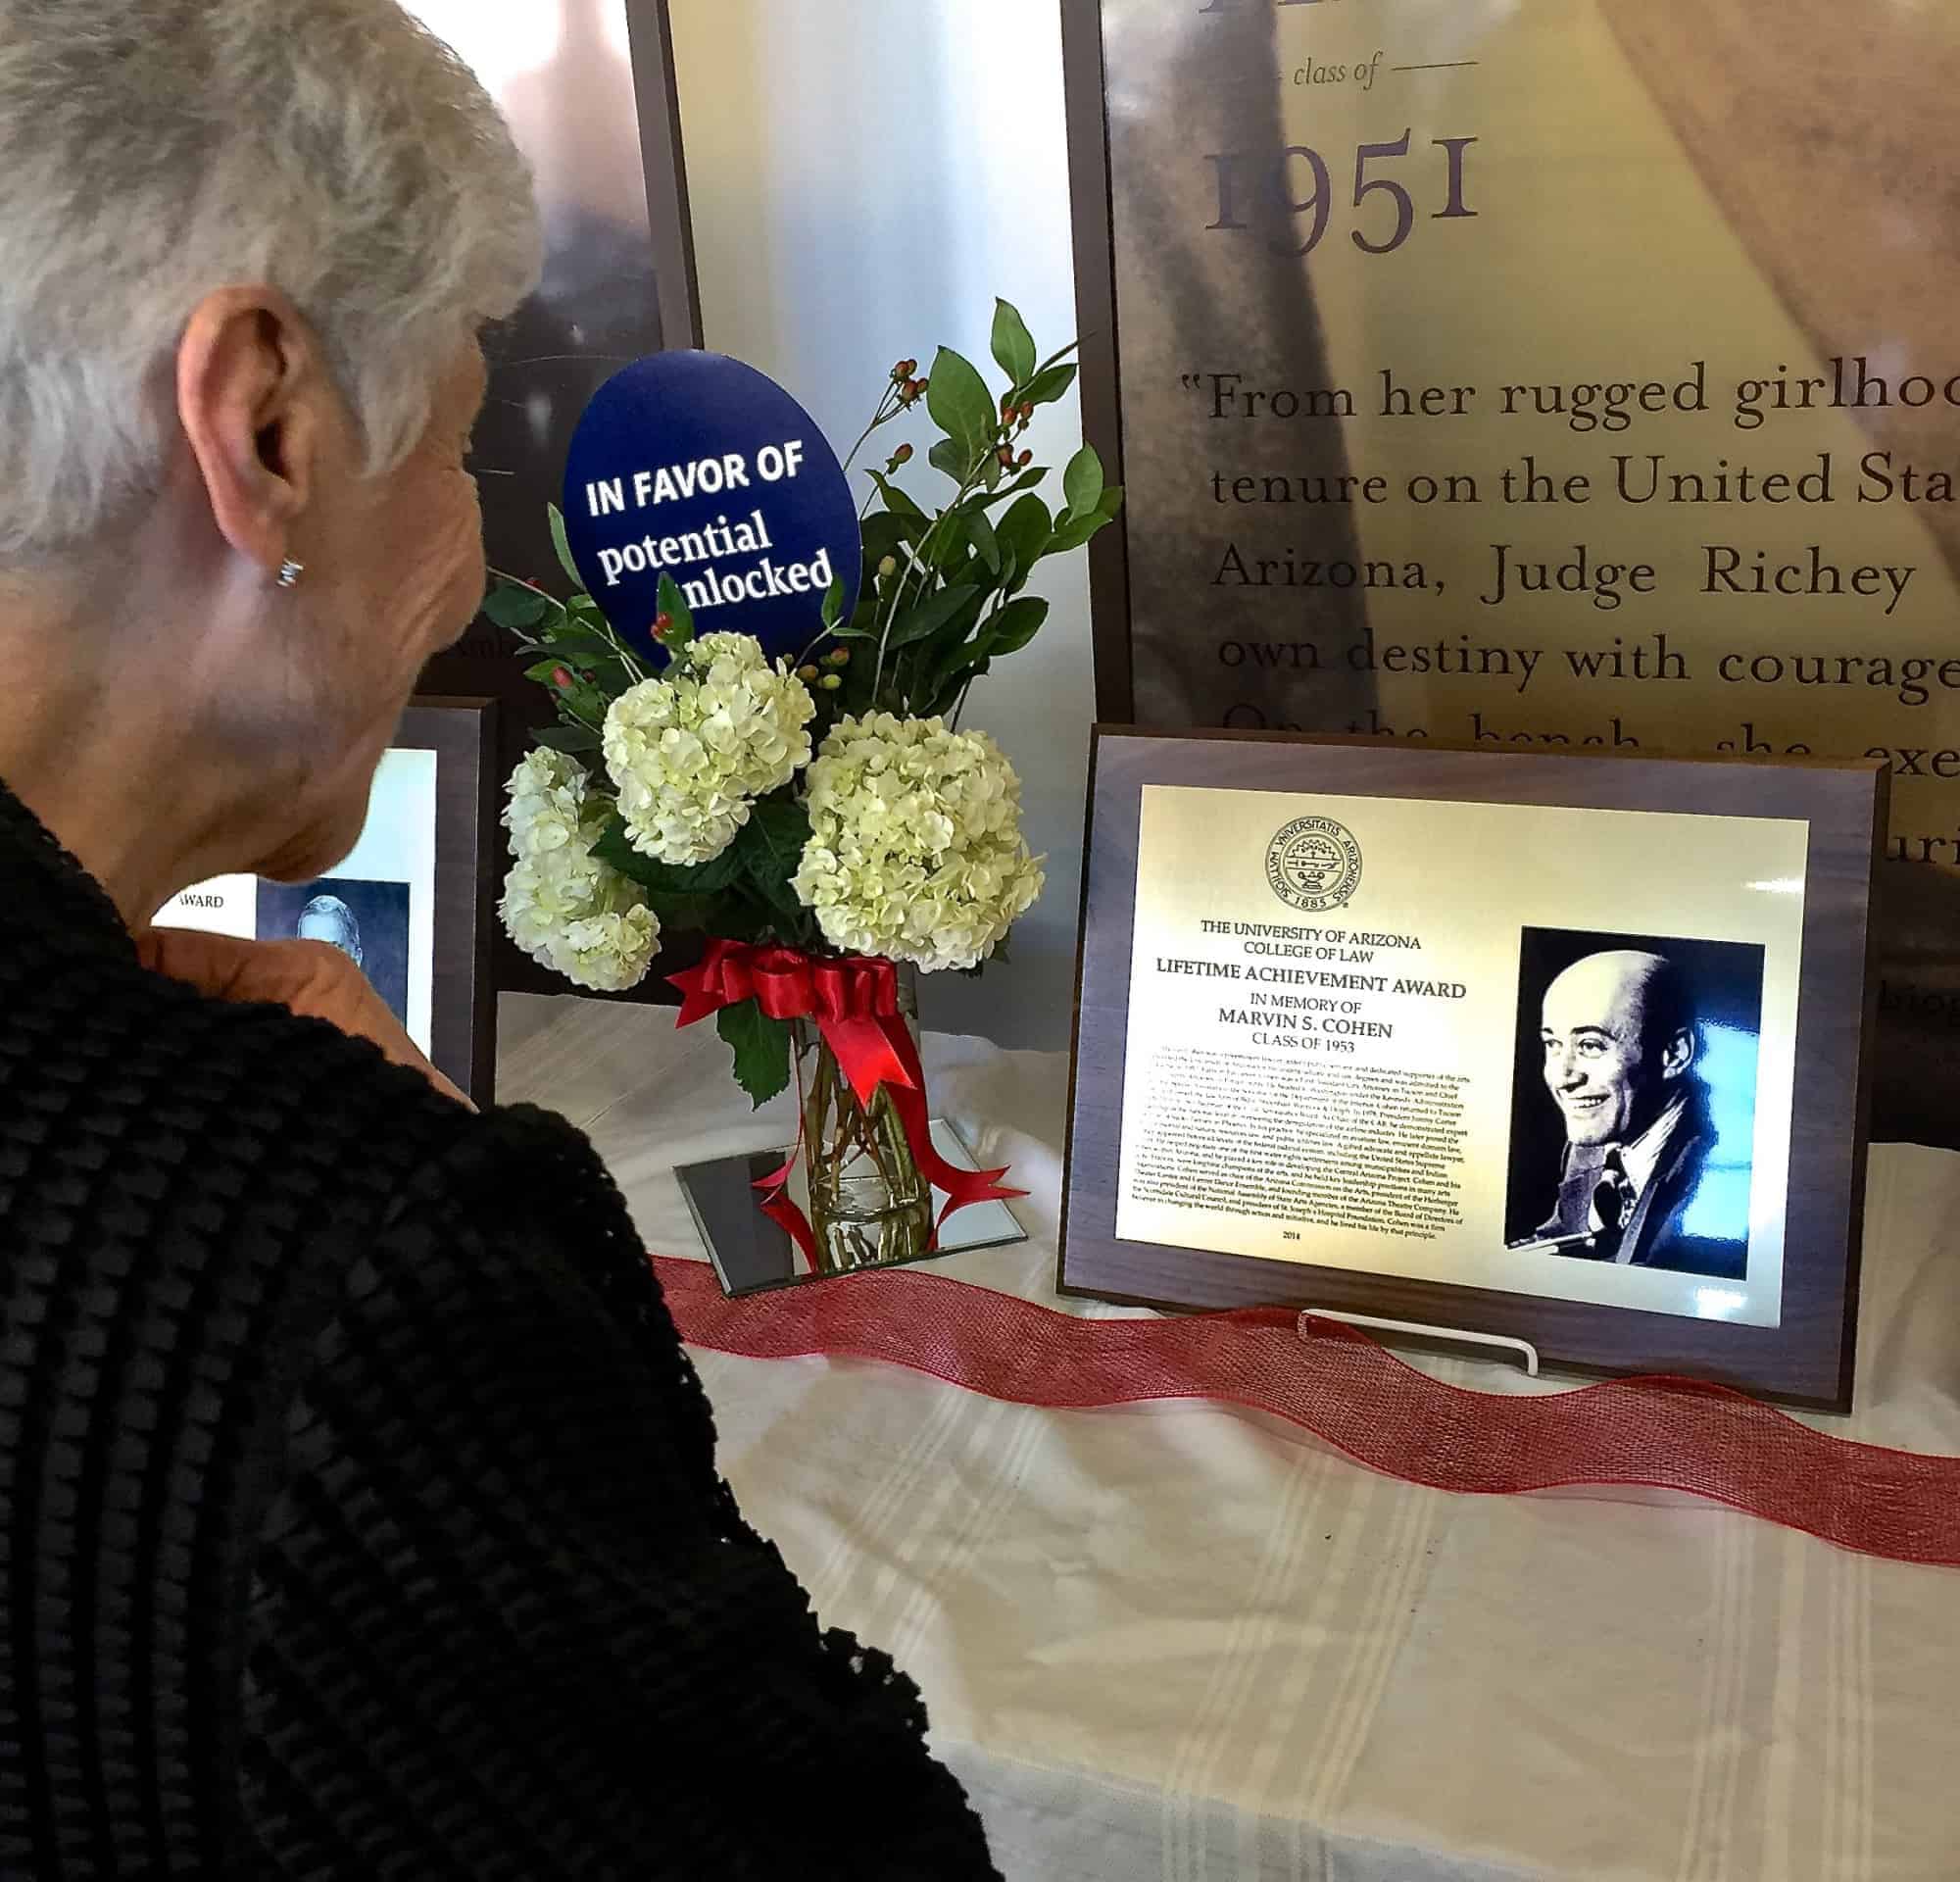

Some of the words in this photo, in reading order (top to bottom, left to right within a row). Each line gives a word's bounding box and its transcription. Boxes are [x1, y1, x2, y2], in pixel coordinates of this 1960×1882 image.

[1293, 57, 1346, 86] class
[1353, 50, 1384, 90] of
[1202, 127, 1479, 257] 1951
[1379, 370, 1476, 416] her
[1499, 361, 1709, 431] rugged
[586, 477, 625, 517] IN
[633, 454, 750, 508] FAVOR
[757, 440, 804, 481] OF
[1210, 470, 1388, 504] tenure
[1407, 474, 1483, 504] on
[1499, 456, 1591, 504] the
[1609, 452, 1836, 504] United
[597, 509, 773, 586] potential
[657, 547, 834, 610] nlocked
[1209, 542, 1445, 597] Arizona,
[1480, 544, 1656, 611] Judge
[1699, 545, 1917, 615] Richey
[1218, 639, 1324, 669] own
[1347, 627, 1544, 693] destiny
[1564, 633, 1691, 679] with
[1718, 654, 1960, 706] courage
[1295, 897, 1326, 908] 1885
[1200, 920, 1231, 934] THE
[1235, 923, 1323, 941] UNIVERSITY
[1326, 930, 1346, 943] OF
[1349, 931, 1421, 949] ARIZONA
[1244, 941, 1312, 958] COLLEGE
[1316, 947, 1336, 960] OF
[1340, 948, 1374, 963] LAW
[1156, 958, 1241, 979] LIFETIME
[1245, 966, 1388, 992] ACHIEVEMENT
[1393, 978, 1466, 998] AWARD
[1219, 1008, 1297, 1029] MARVIN
[1302, 1017, 1318, 1031] S.
[1322, 1018, 1393, 1038] COHEN
[1250, 993, 1267, 1005] IN
[1271, 994, 1339, 1012] MEMORY
[1341, 1001, 1362, 1014] OF
[1252, 1032, 1298, 1048] CLASS
[1302, 1037, 1321, 1050] OF
[1326, 1040, 1355, 1053] 1953
